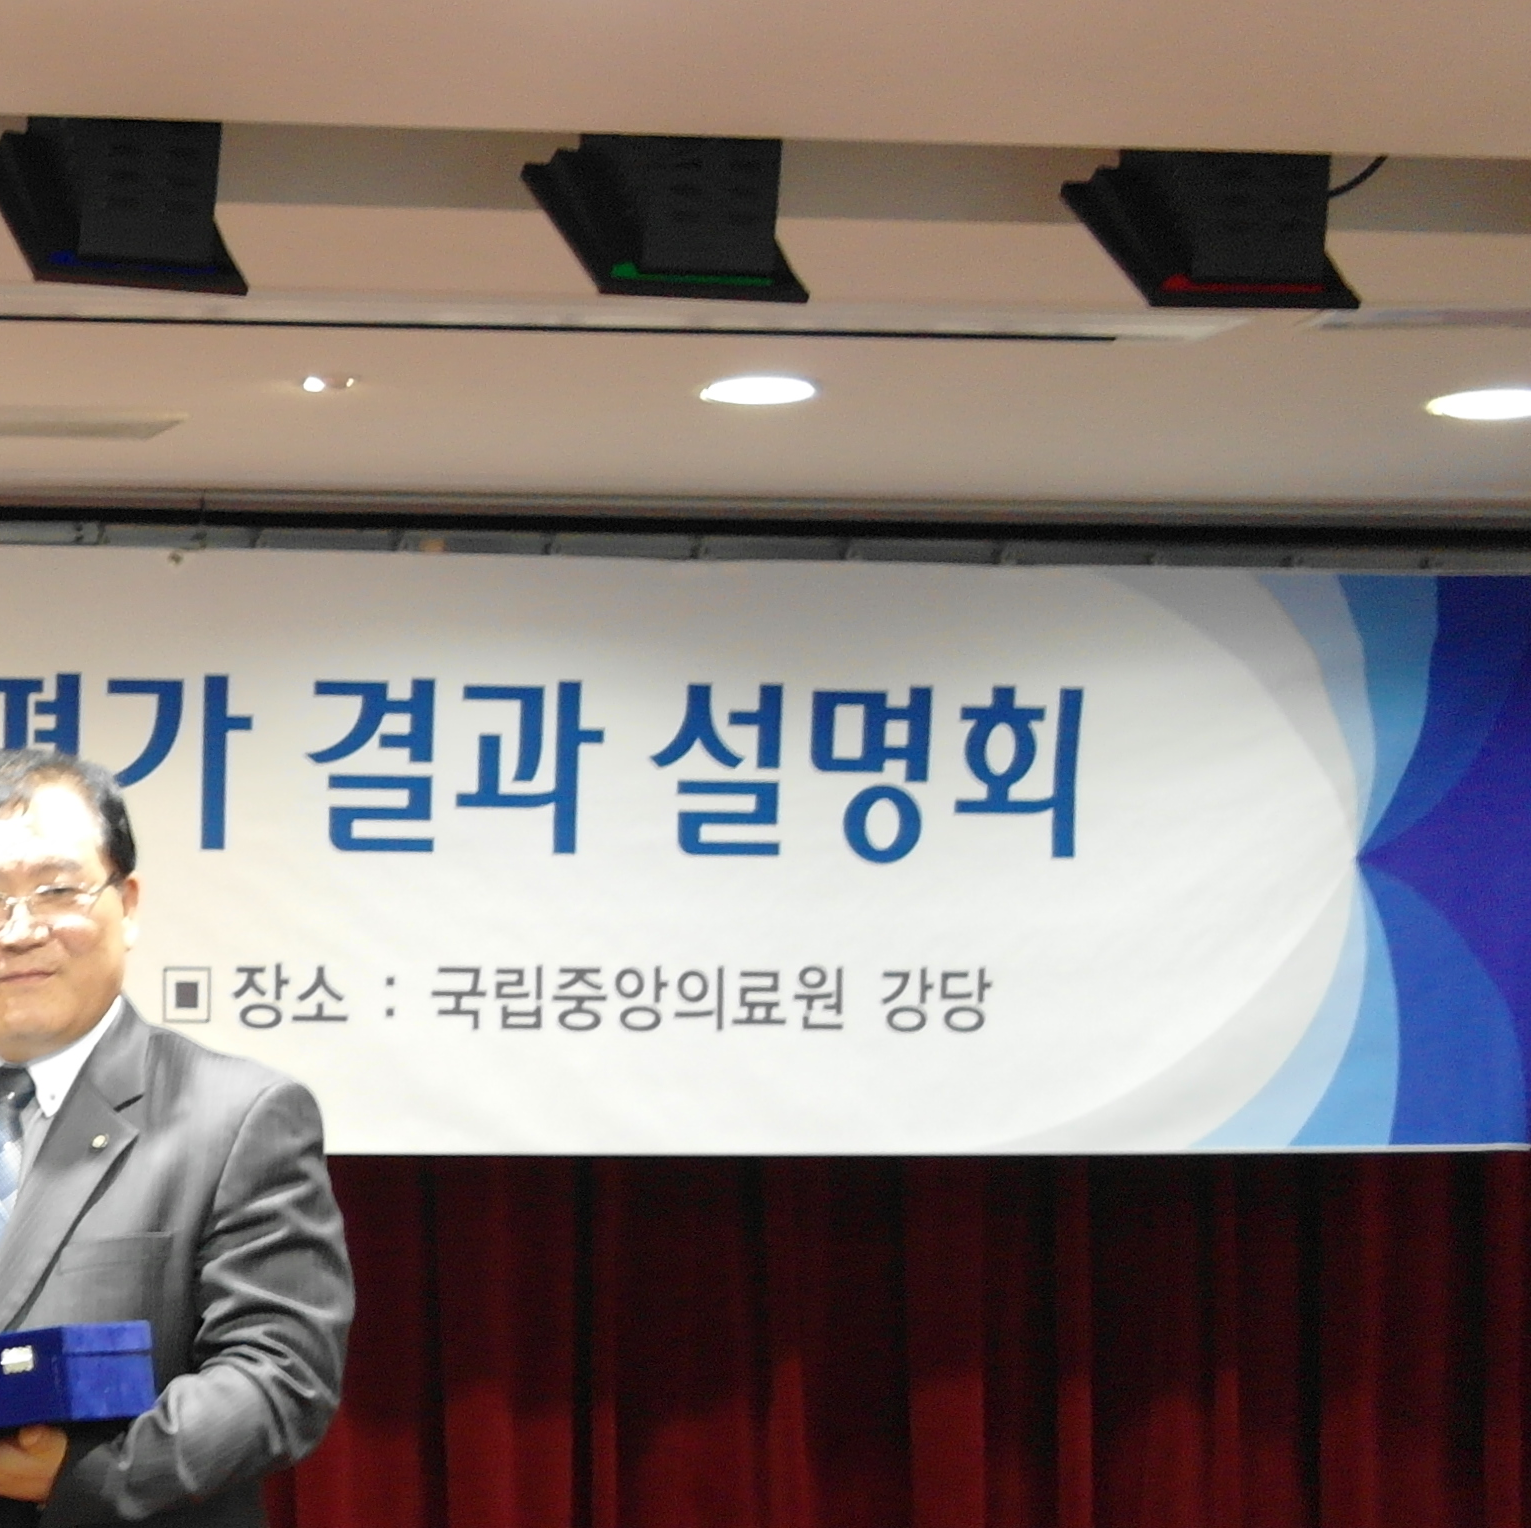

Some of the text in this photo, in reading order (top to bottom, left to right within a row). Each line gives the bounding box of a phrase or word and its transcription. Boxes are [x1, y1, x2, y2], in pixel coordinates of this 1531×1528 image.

[305, 676, 605, 855] 결과
[650, 681, 1085, 864] 설명회
[232, 965, 349, 1030] 장소
[430, 963, 846, 1031] 국립중앙의료원
[881, 966, 993, 1032] 강당
